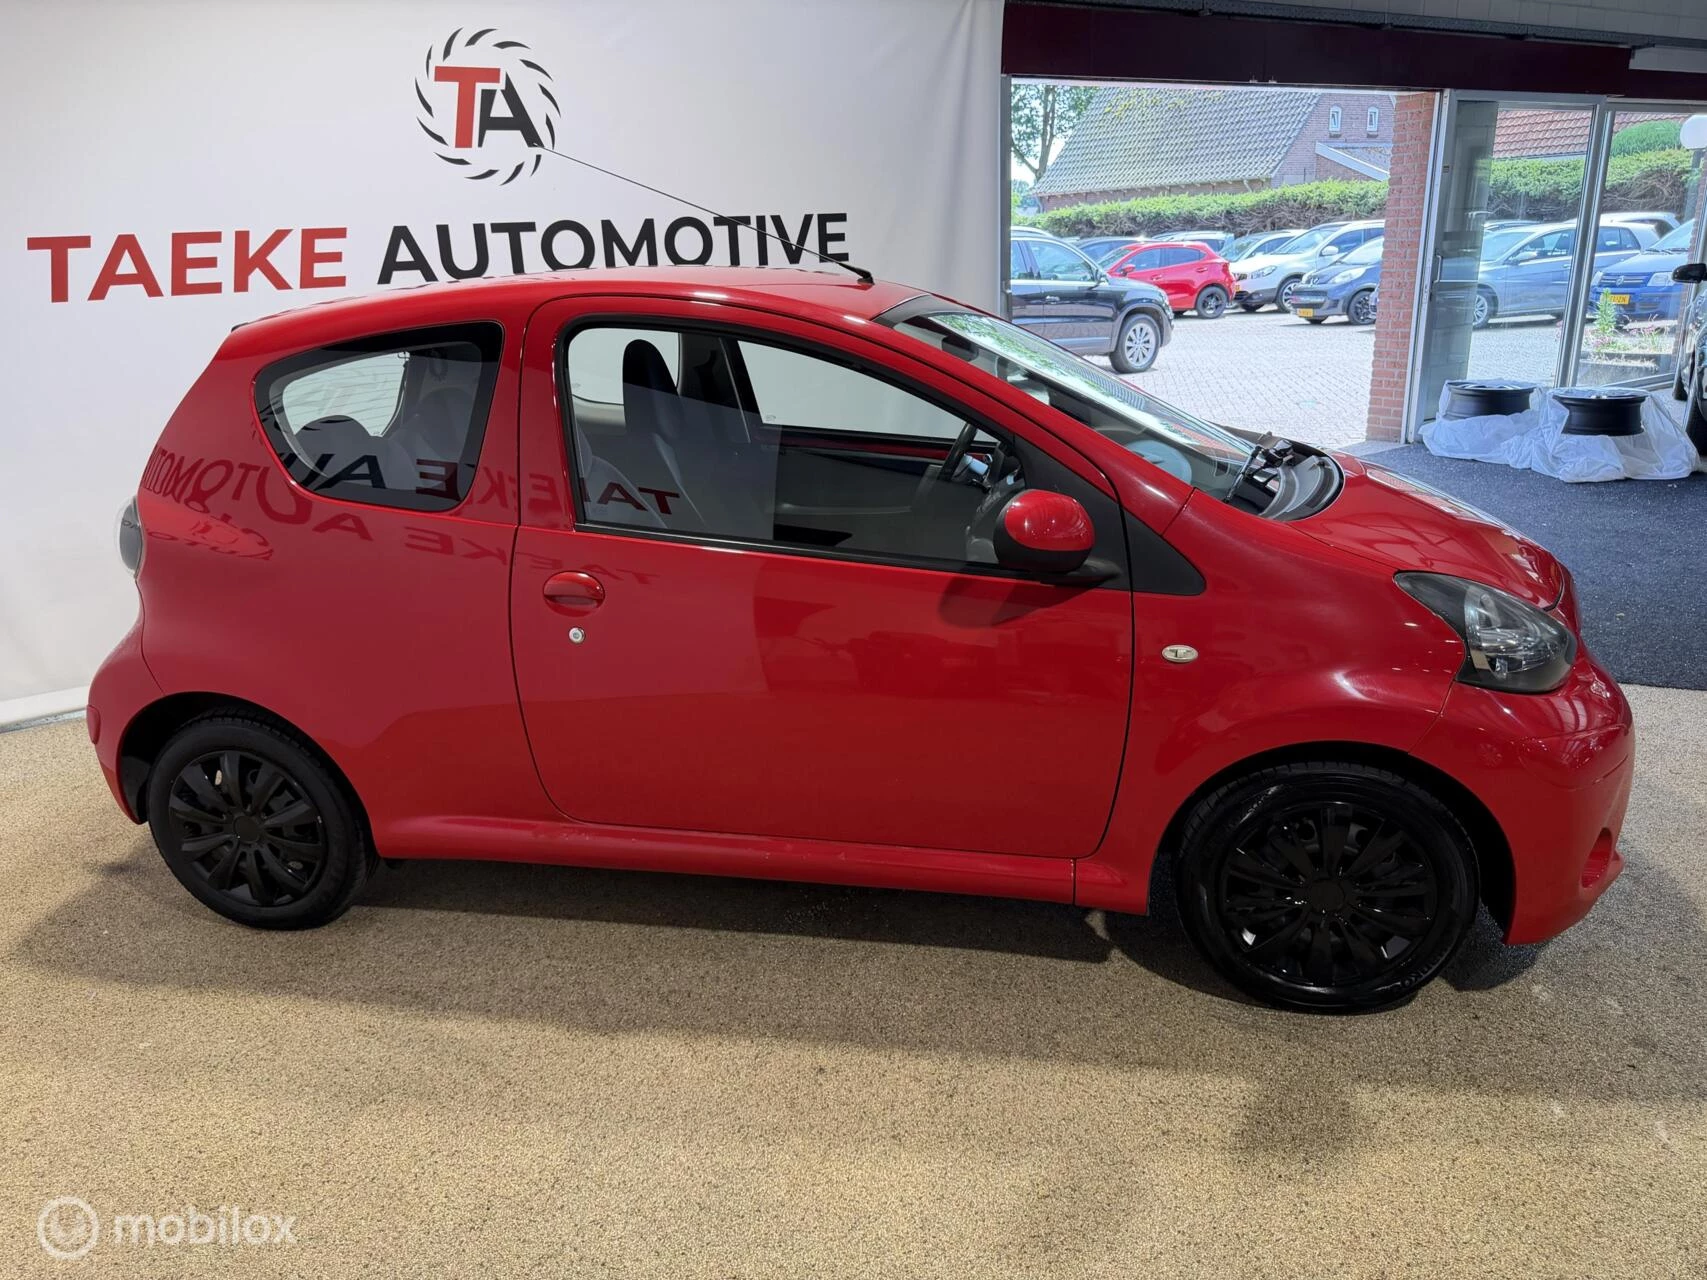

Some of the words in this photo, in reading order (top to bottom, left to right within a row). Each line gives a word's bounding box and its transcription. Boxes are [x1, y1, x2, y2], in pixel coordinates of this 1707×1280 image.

[434, 65, 545, 148] TA
[27, 227, 348, 303] TAEKE
[377, 212, 849, 285] AUTOMOTIVE
